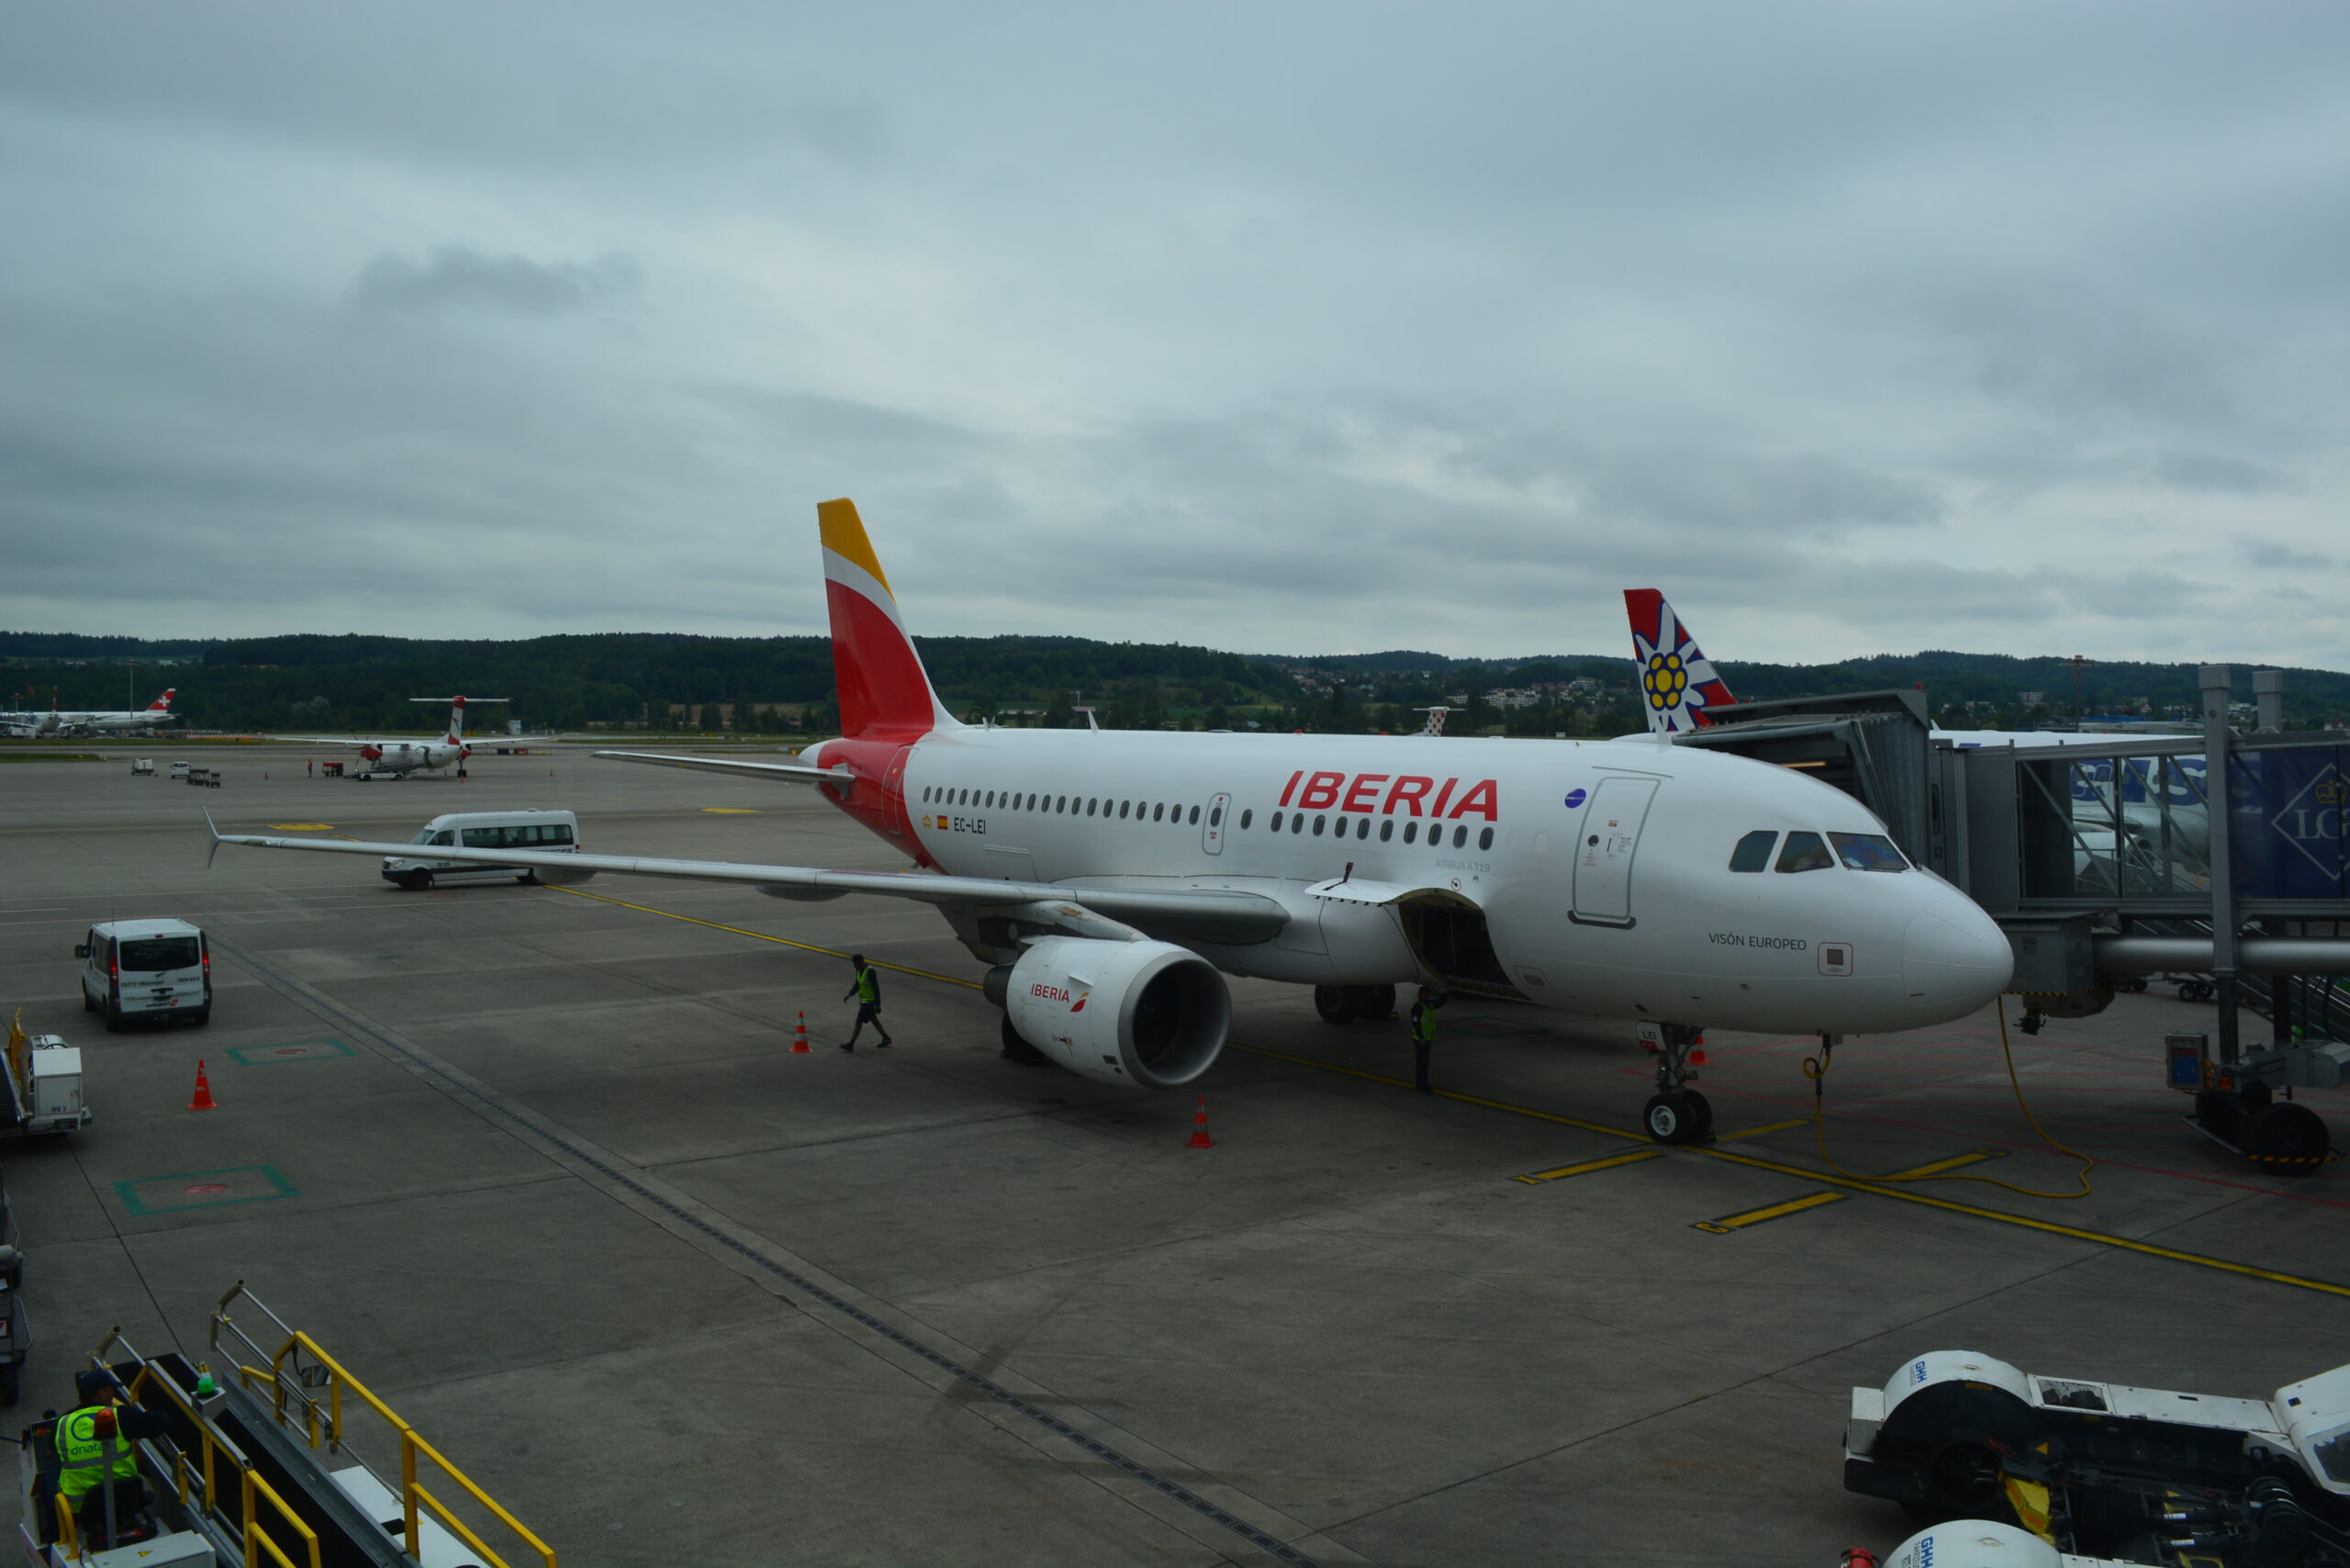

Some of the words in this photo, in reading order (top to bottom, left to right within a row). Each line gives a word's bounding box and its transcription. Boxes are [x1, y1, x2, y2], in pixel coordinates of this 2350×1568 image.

[1279, 770, 1498, 822] IBERIA
[954, 817, 986, 834] EC-LEI
[1435, 858, 1466, 870] AIRBUS
[1466, 861, 1491, 872] A319
[1708, 932, 1745, 946] VISÓN
[1749, 936, 1807, 950] EUROPEO
[1031, 983, 1069, 1002] IBERIA
[1915, 1361, 1927, 1383] GHH
[1920, 1536, 1933, 1568] GHH
